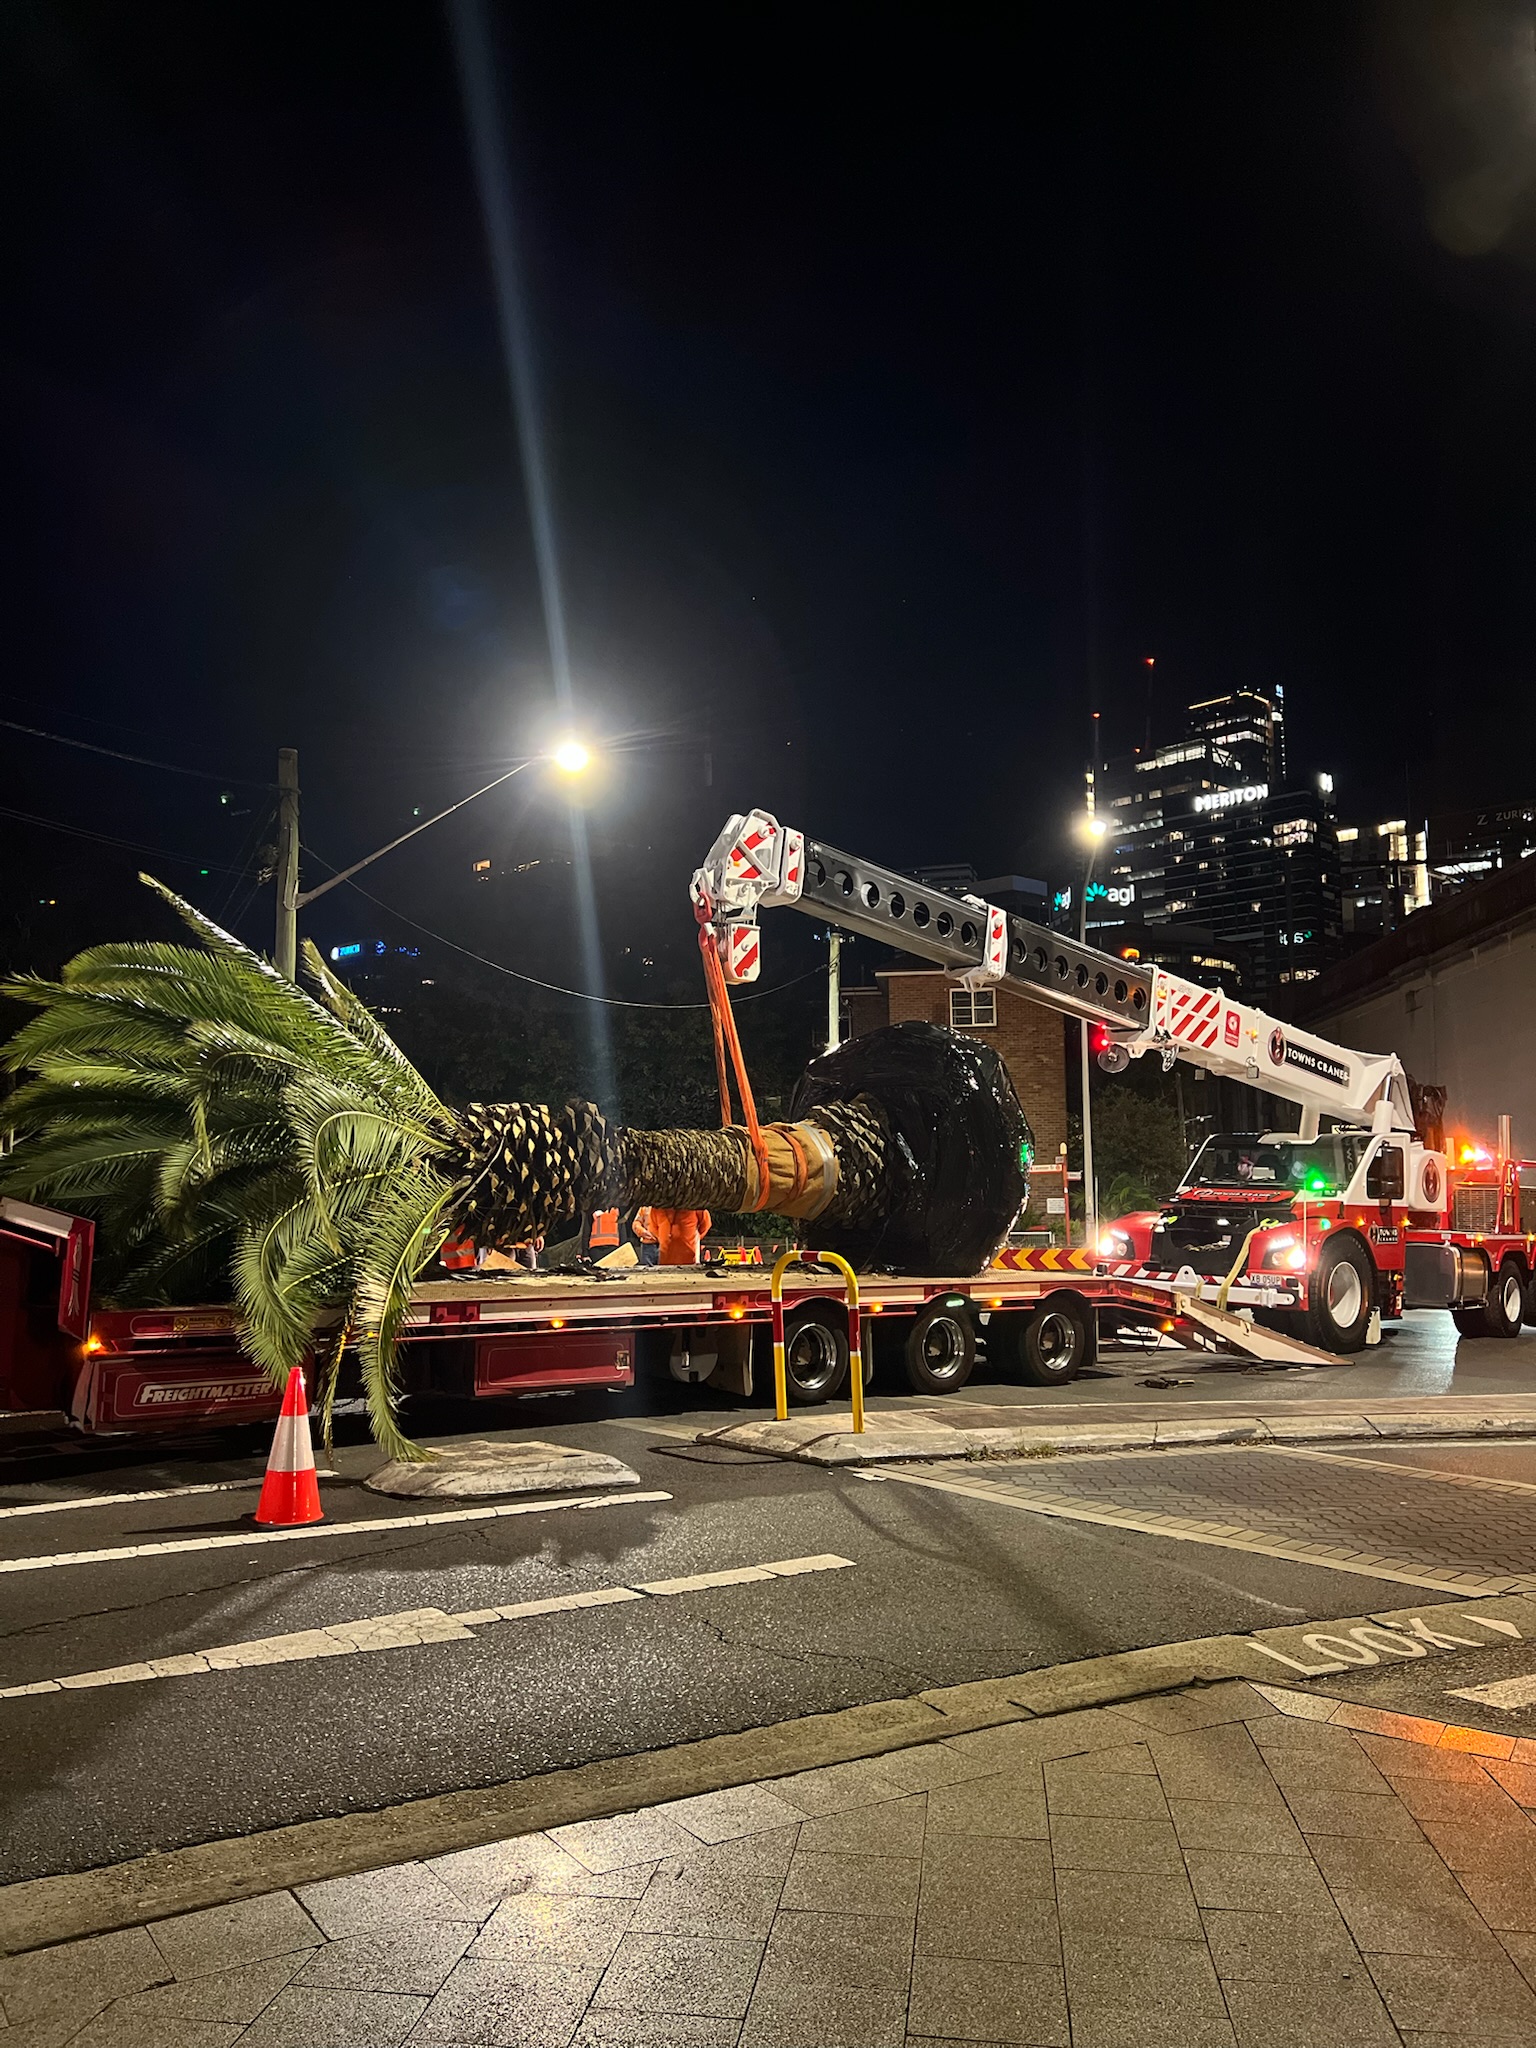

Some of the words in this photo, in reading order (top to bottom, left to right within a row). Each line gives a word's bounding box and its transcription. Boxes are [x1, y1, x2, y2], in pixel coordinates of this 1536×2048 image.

[1194, 783, 1269, 813] MERITON
[1107, 883, 1135, 907] agl
[1287, 1047, 1316, 1068] TOWNS
[1316, 1060, 1350, 1081] CRANES
[139, 1382, 272, 1404] FREIGHTMASTER
[1246, 1617, 1485, 1676] LOOK
